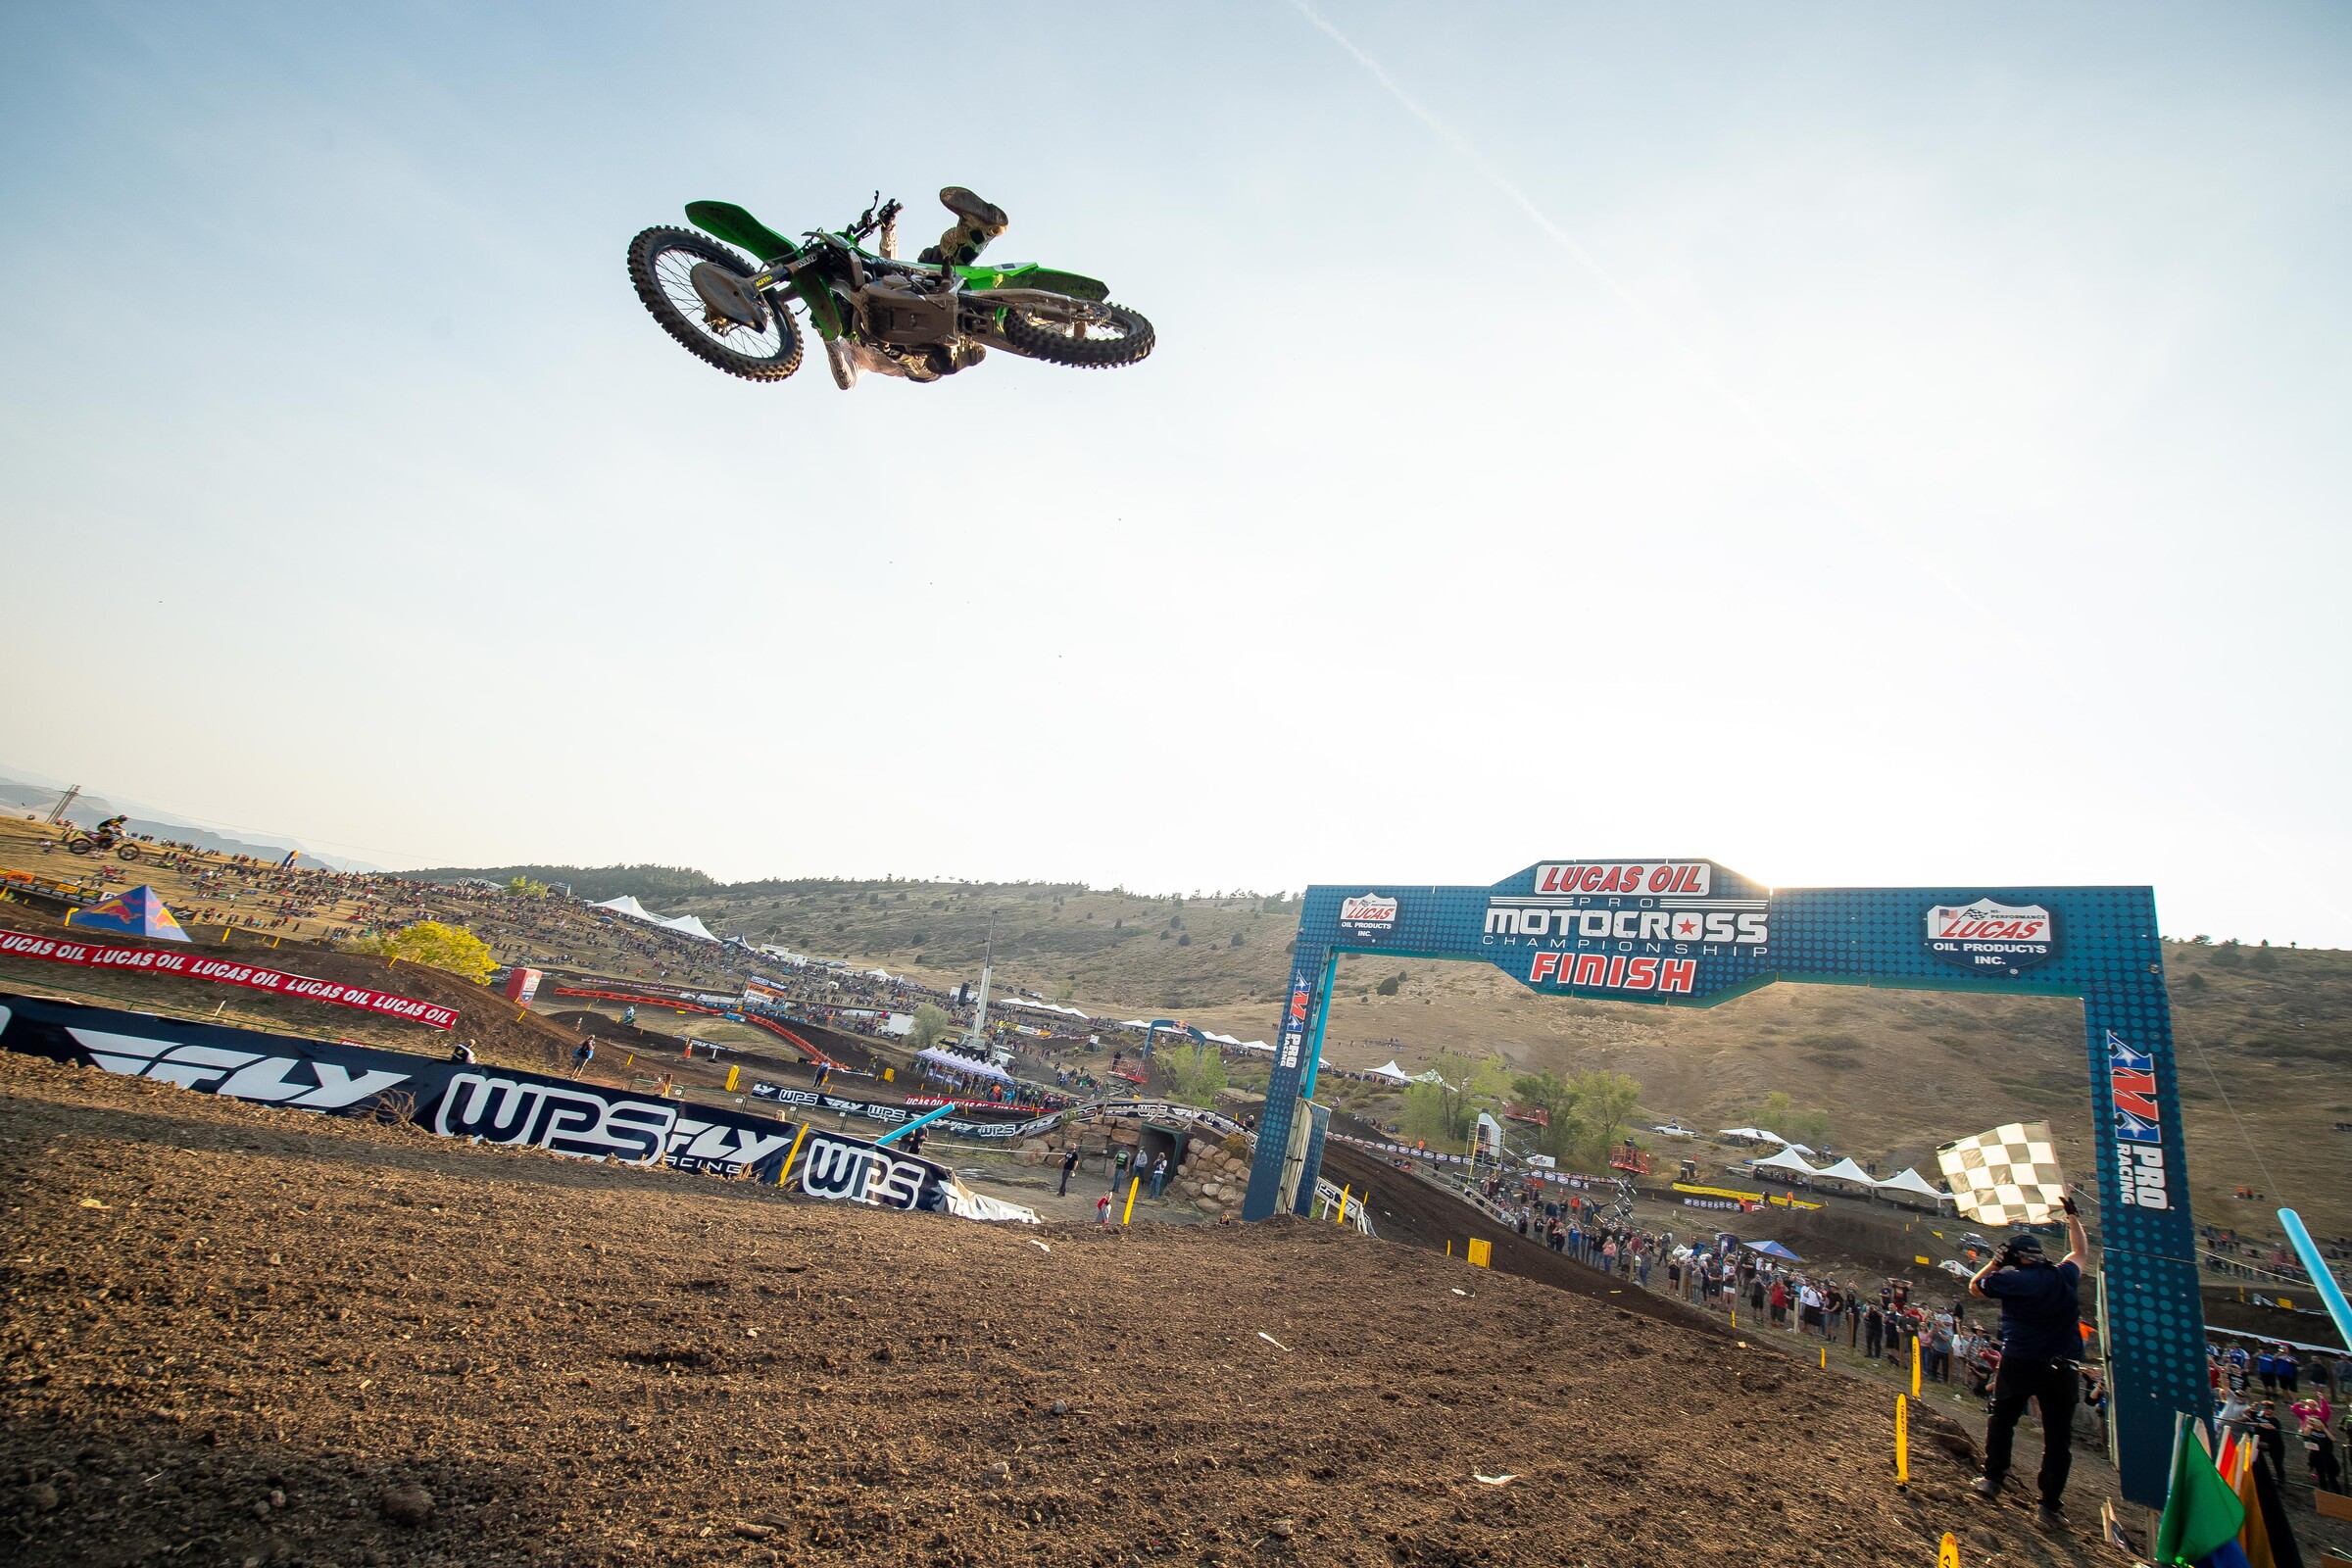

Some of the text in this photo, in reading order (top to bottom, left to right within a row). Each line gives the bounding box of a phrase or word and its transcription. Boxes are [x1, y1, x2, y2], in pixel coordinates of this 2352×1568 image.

[1541, 866, 1701, 893] LUCAS OIL
[1346, 906, 1396, 920] LUCAS
[1579, 897, 1654, 908] PRO
[1484, 907, 1769, 944] MOTOCROSS
[1940, 920, 2044, 940] LUCAS
[55, 945, 87, 961] OIL
[91, 949, 186, 971] LUCAS OIL
[1482, 935, 1768, 957] CHAMPIONSHIP
[1933, 942, 2047, 954] OIL PRODUCTS
[1974, 956, 2007, 964] INC.
[189, 960, 282, 989] LUCAS OIL
[1529, 952, 1697, 994] FINISH
[283, 978, 371, 1005] LUCAS OIL
[1287, 968, 1311, 1033] AMA
[371, 995, 452, 1025] LUCAS OIL
[1280, 1033, 1292, 1067] RACING
[1286, 1033, 1301, 1068] PRO
[64, 1027, 413, 1108] FLY
[2106, 1029, 2162, 1144] AMA
[753, 1083, 906, 1123] LY WPS FLY WPS
[435, 1072, 677, 1167] WPS
[665, 1117, 793, 1164] FLY
[662, 1153, 743, 1175] ACING
[803, 1138, 926, 1210] WPS
[2116, 1143, 2136, 1205] RACING
[2132, 1145, 2168, 1210] PRO
